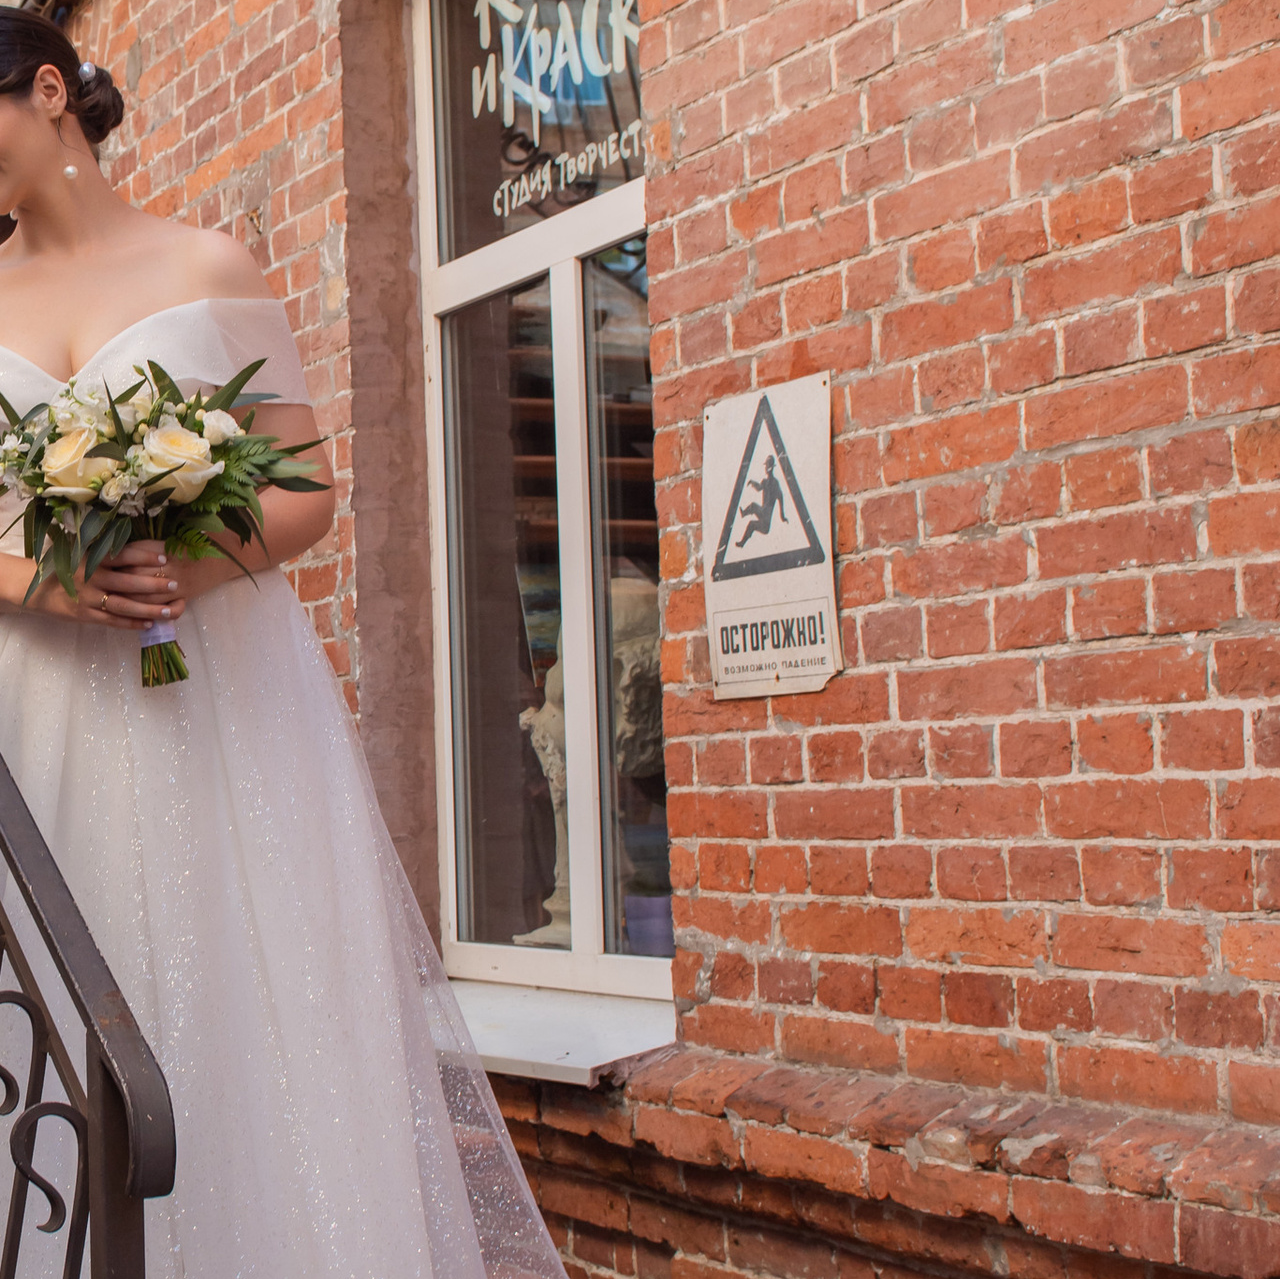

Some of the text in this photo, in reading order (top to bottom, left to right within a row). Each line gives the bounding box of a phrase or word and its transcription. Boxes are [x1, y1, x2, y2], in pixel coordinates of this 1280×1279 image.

[492, 159, 553, 218] СТУДИЯ
[720, 611, 825, 655] ОСТОРОЖНО!
[724, 656, 827, 675] ВОЗМОЖНО ПАДЕНИЕ
